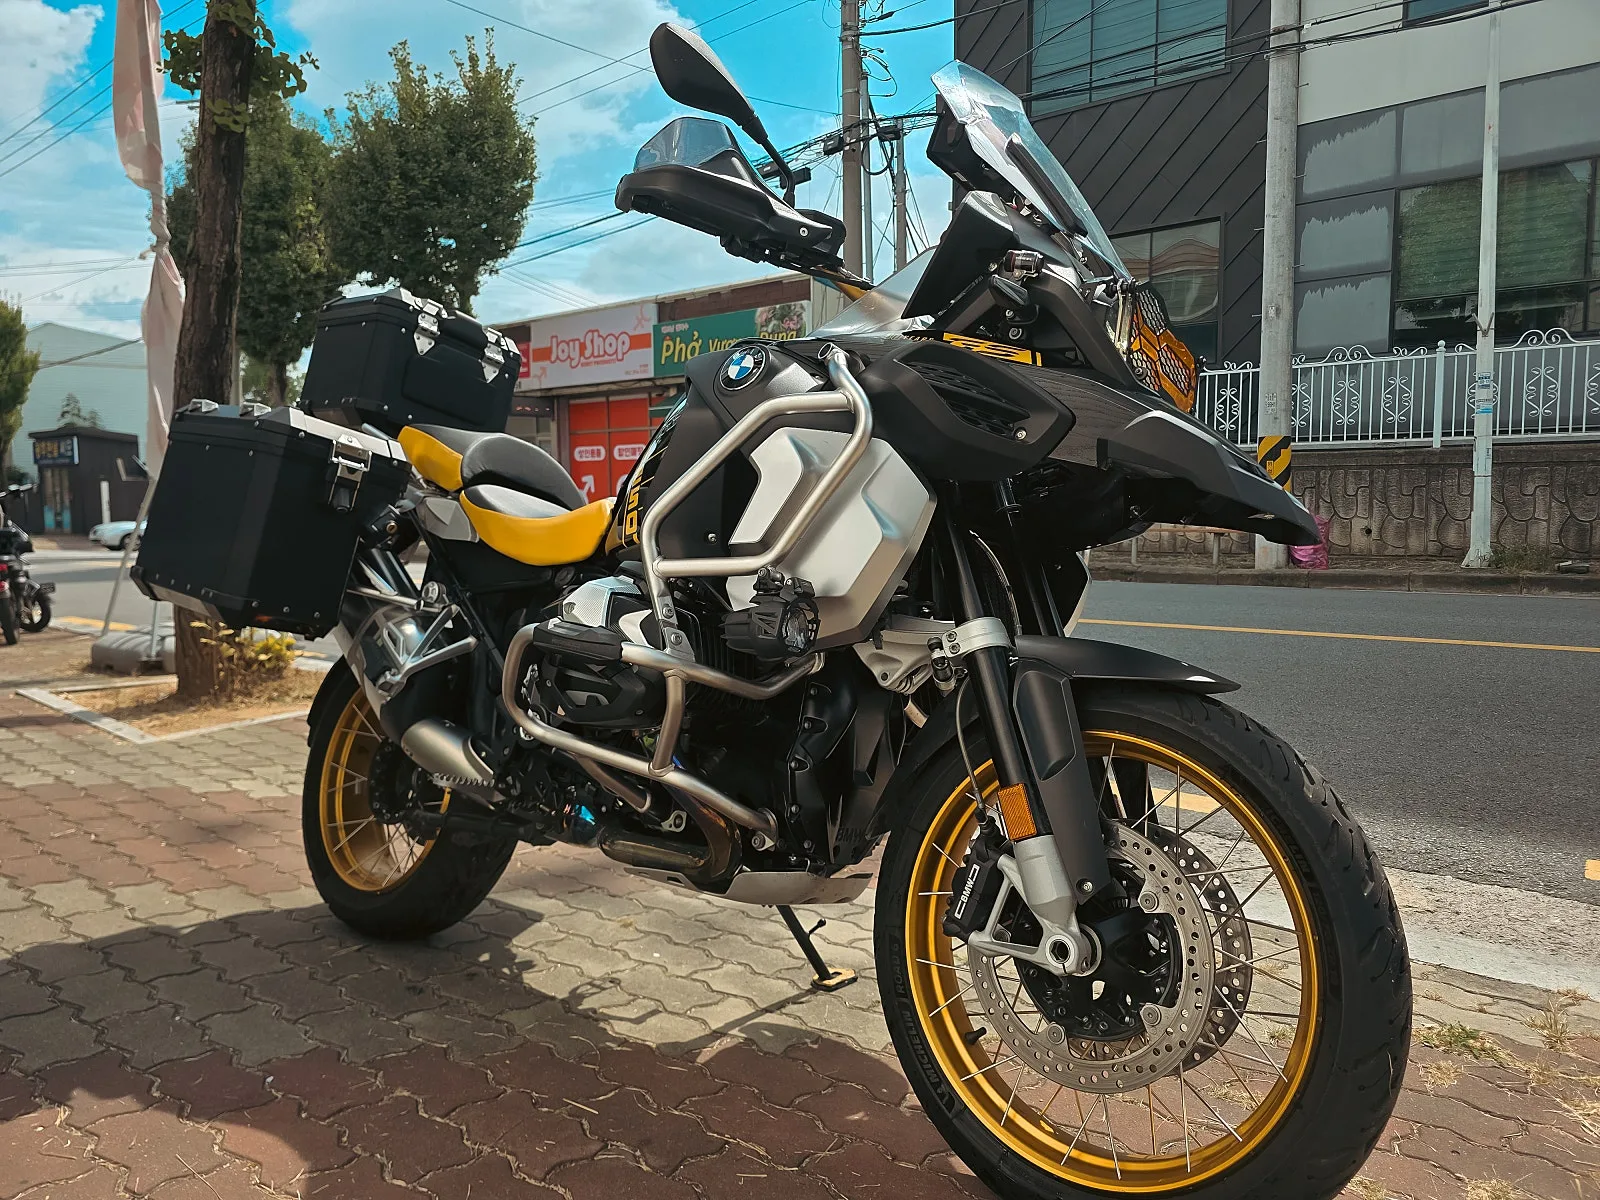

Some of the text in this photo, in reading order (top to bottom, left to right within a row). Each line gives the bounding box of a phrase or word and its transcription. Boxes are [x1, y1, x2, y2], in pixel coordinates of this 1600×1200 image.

[550, 335, 581, 369] Joy
[584, 328, 631, 362] Shop
[960, 877, 975, 903] BMW
[902, 1010, 940, 1083] MICHELIN
